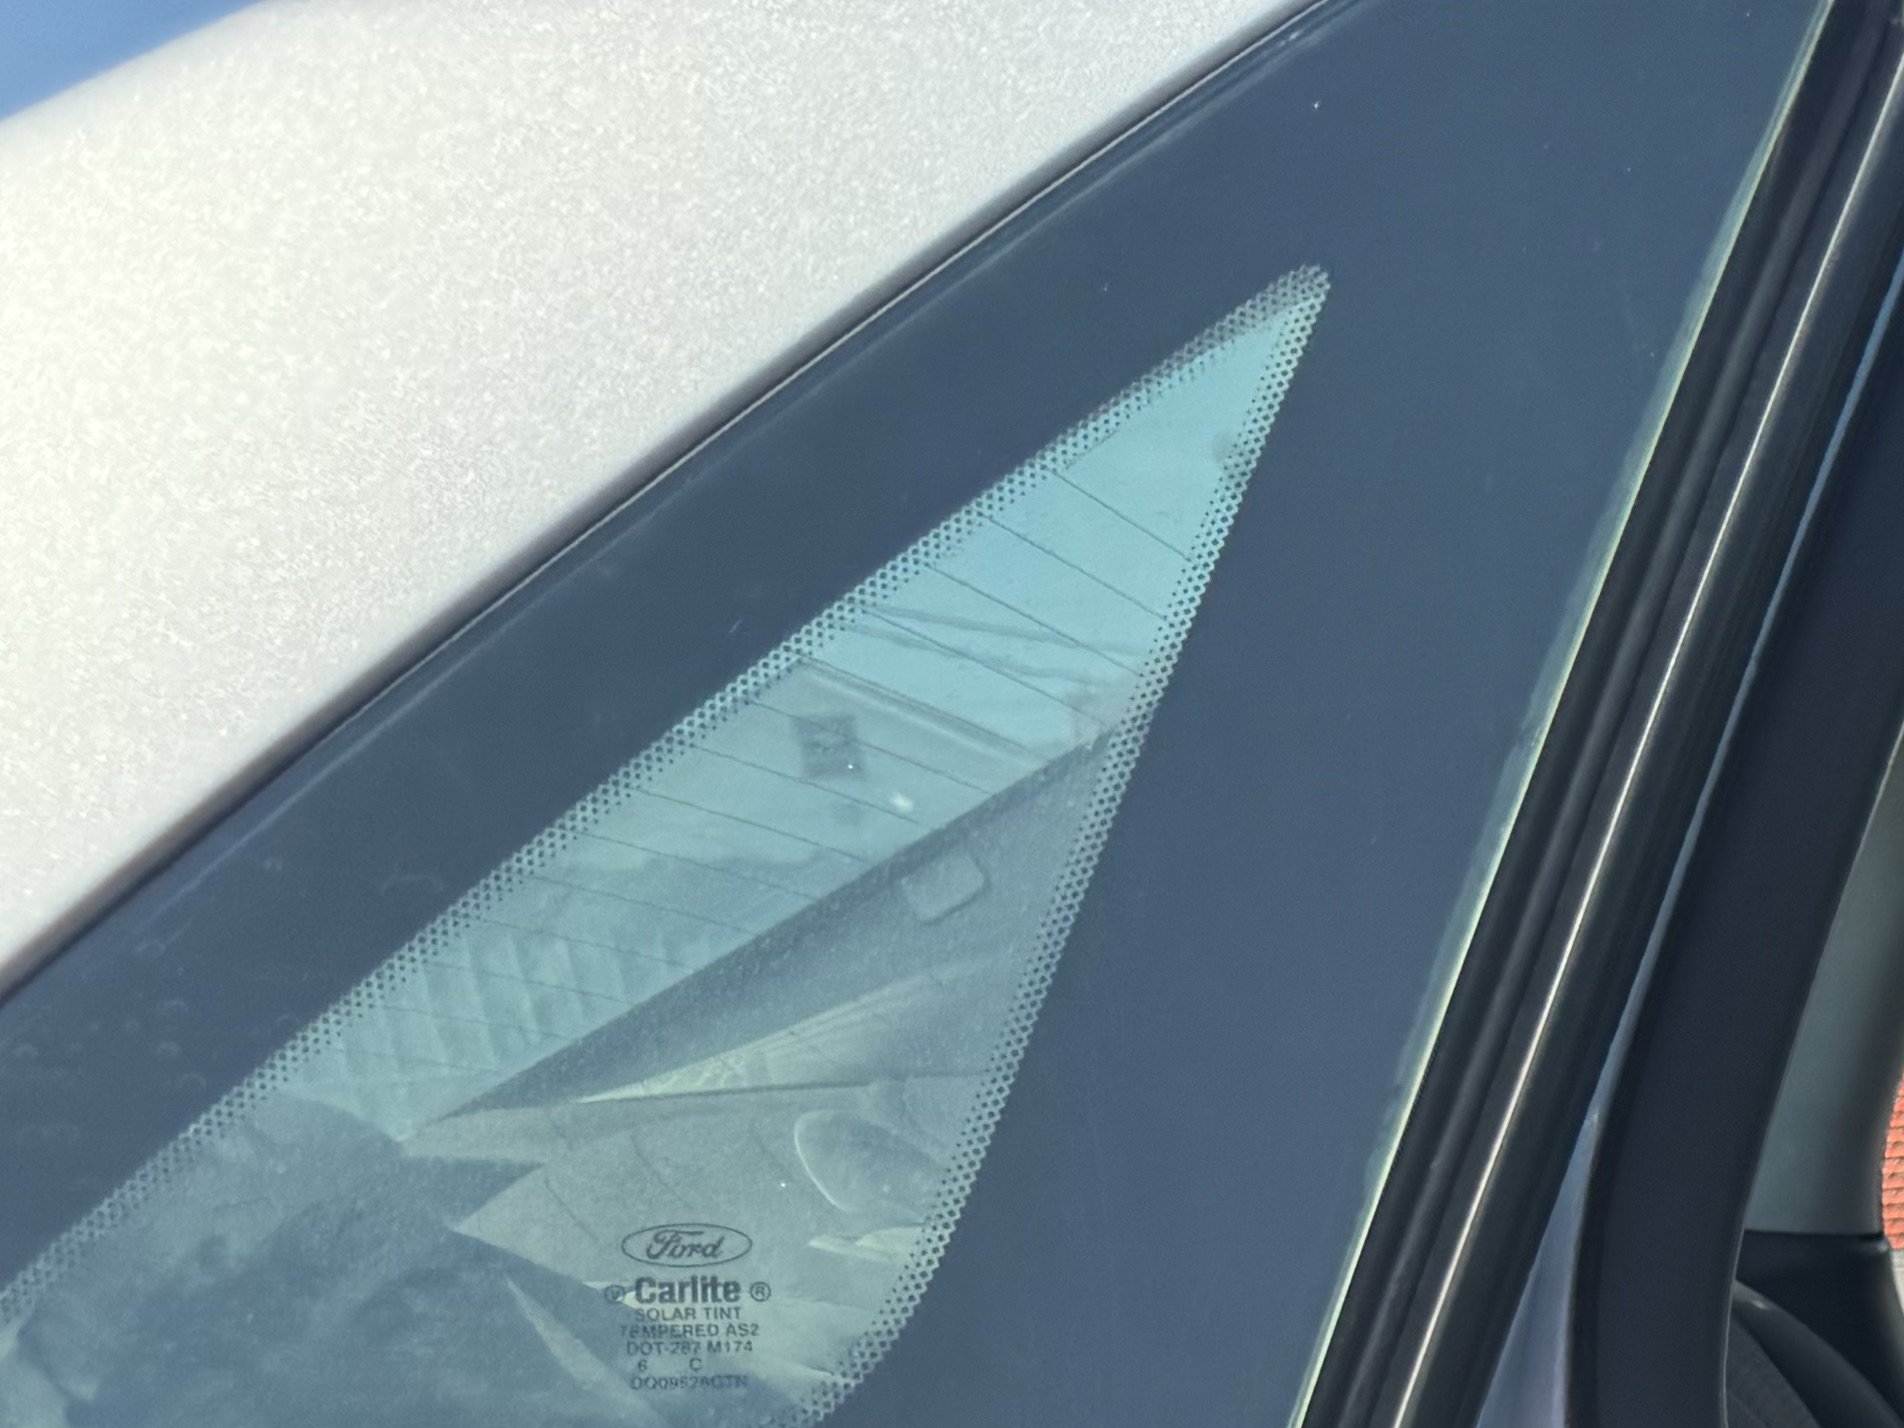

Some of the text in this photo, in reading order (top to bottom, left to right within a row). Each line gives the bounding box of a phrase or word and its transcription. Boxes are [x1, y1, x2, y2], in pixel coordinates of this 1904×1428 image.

[646, 1229, 725, 1260] Ford
[634, 1275, 742, 1304] Carlite
[635, 1306, 742, 1321] SOLAR TINT
[620, 1322, 760, 1339] TEMPERED AS2
